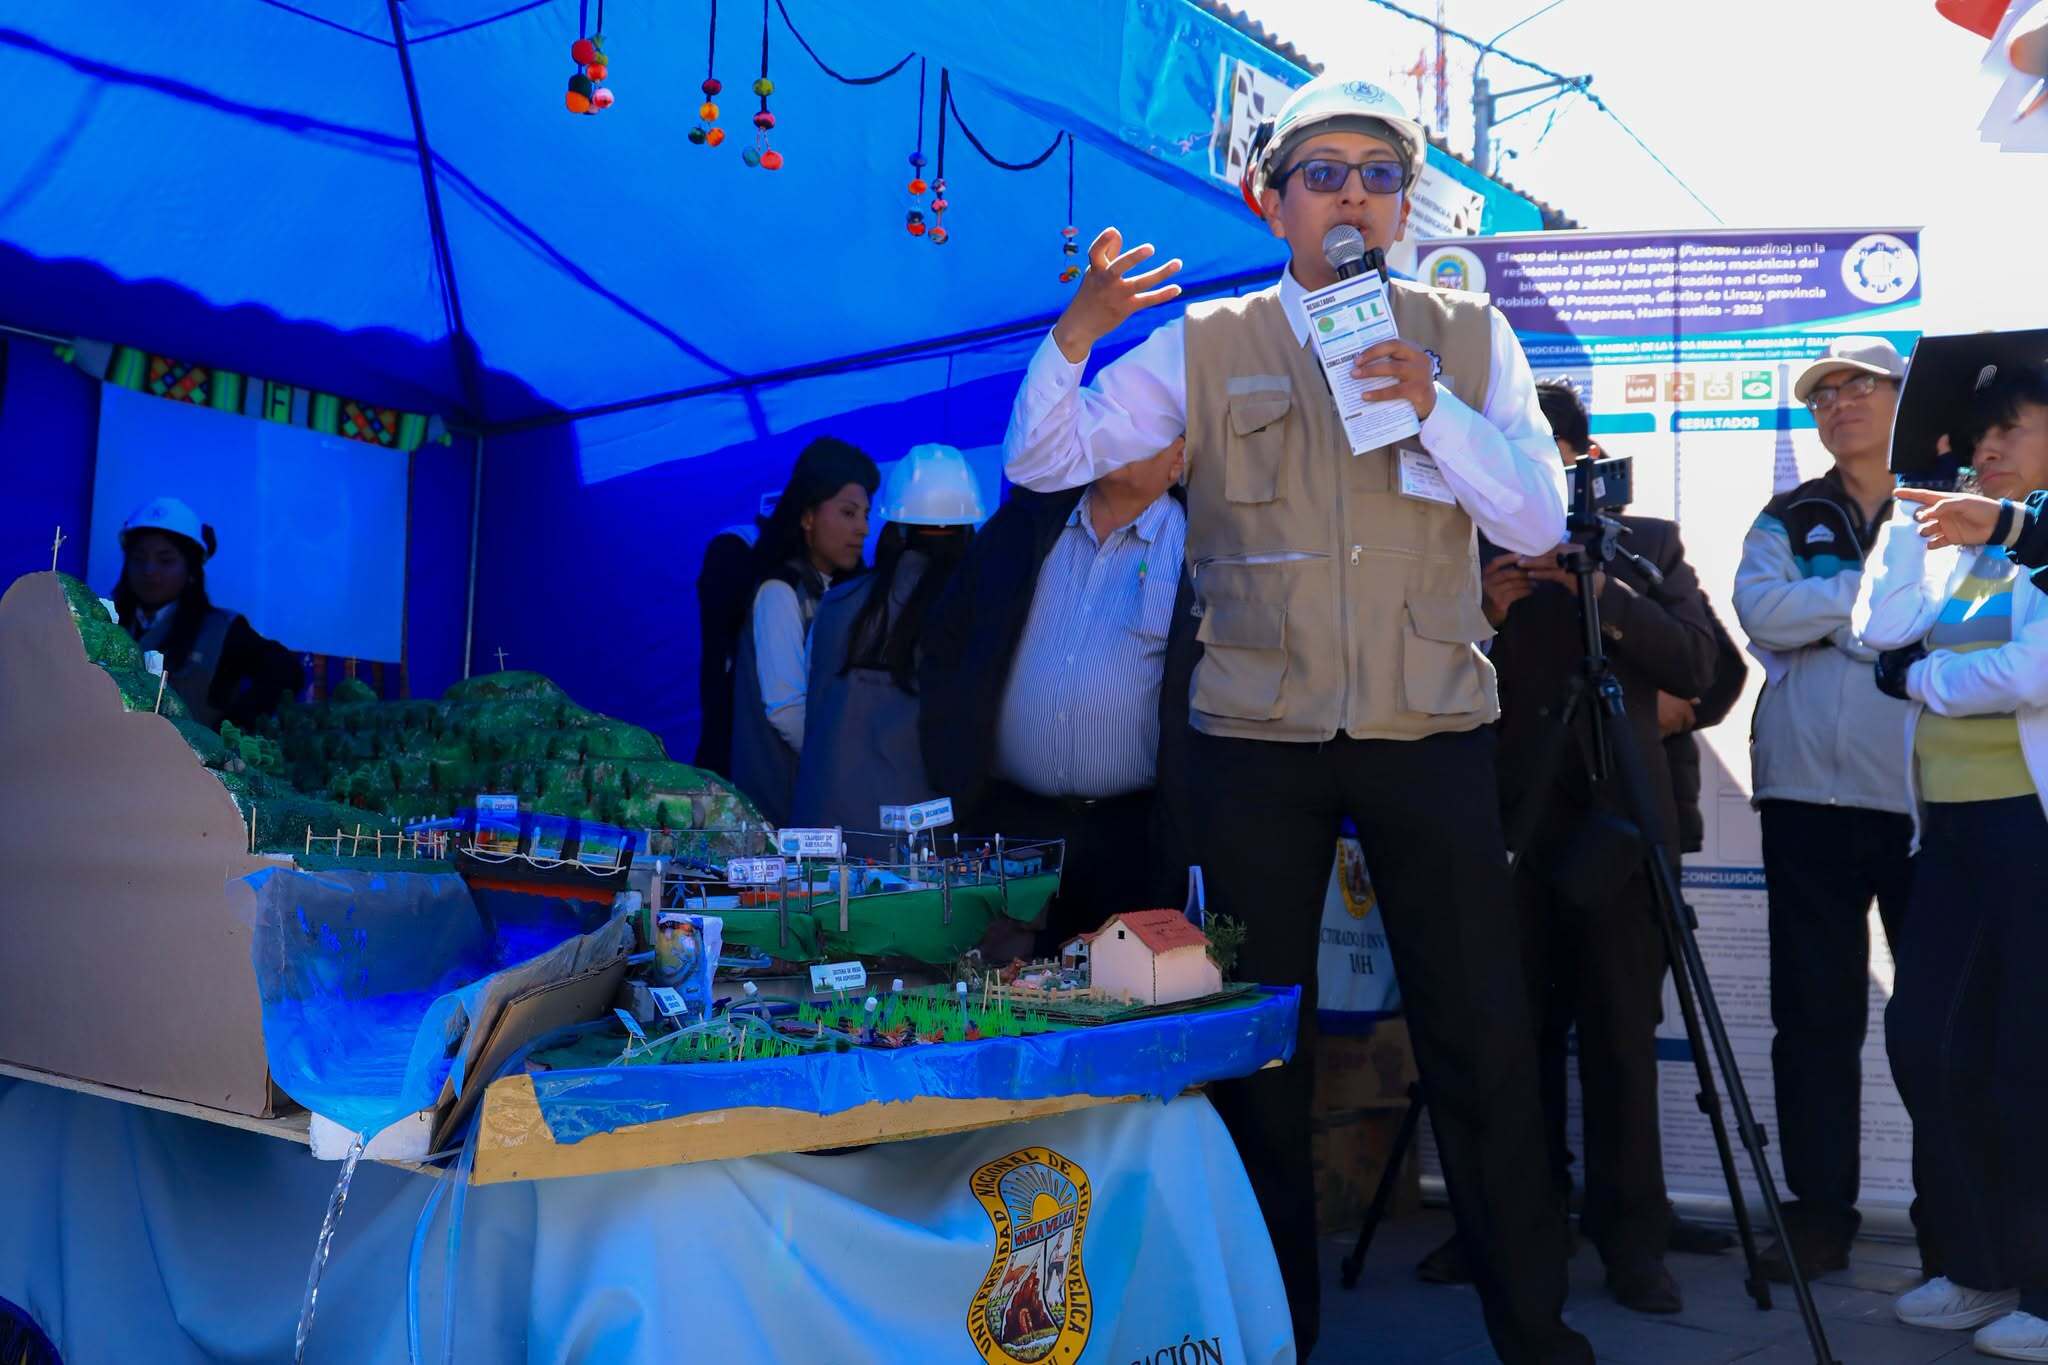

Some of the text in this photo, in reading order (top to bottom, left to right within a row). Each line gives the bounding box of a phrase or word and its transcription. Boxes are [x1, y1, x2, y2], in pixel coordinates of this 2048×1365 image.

[1537, 250, 1557, 262] del
[1613, 249, 1630, 260] de
[1742, 243, 1792, 256] andina)
[1796, 244, 1811, 254] en
[1815, 242, 1825, 252] la
[1503, 264, 1569, 277] resistencia
[1571, 264, 1583, 275] al
[1584, 265, 1616, 276] agua
[1618, 264, 1627, 276] y
[1628, 262, 1646, 273] las
[1728, 257, 1796, 270] mecánicas
[1798, 257, 1819, 269] del
[1519, 280, 1562, 293] bloque
[1564, 279, 1580, 291] de
[1623, 278, 1651, 290] para
[1653, 274, 1722, 287] edificación
[1724, 275, 1741, 285] en
[1743, 273, 1756, 284] el
[1757, 273, 1802, 285] Centro
[1306, 295, 1337, 311] RESULTADOS
[1496, 297, 1546, 307] Poblado
[1548, 295, 1565, 306] de
[1656, 290, 1702, 303] distrito
[1704, 289, 1721, 301] de
[1723, 288, 1765, 302] Lircay,
[1767, 286, 1826, 301] provincia
[1557, 310, 1572, 321] de
[1732, 304, 1764, 316] 2025
[1679, 416, 1760, 430] RESULTADOS
[971, 1151, 1089, 1356] UNIVERSIDAD NACIONAL DE HUANCAVELICA
